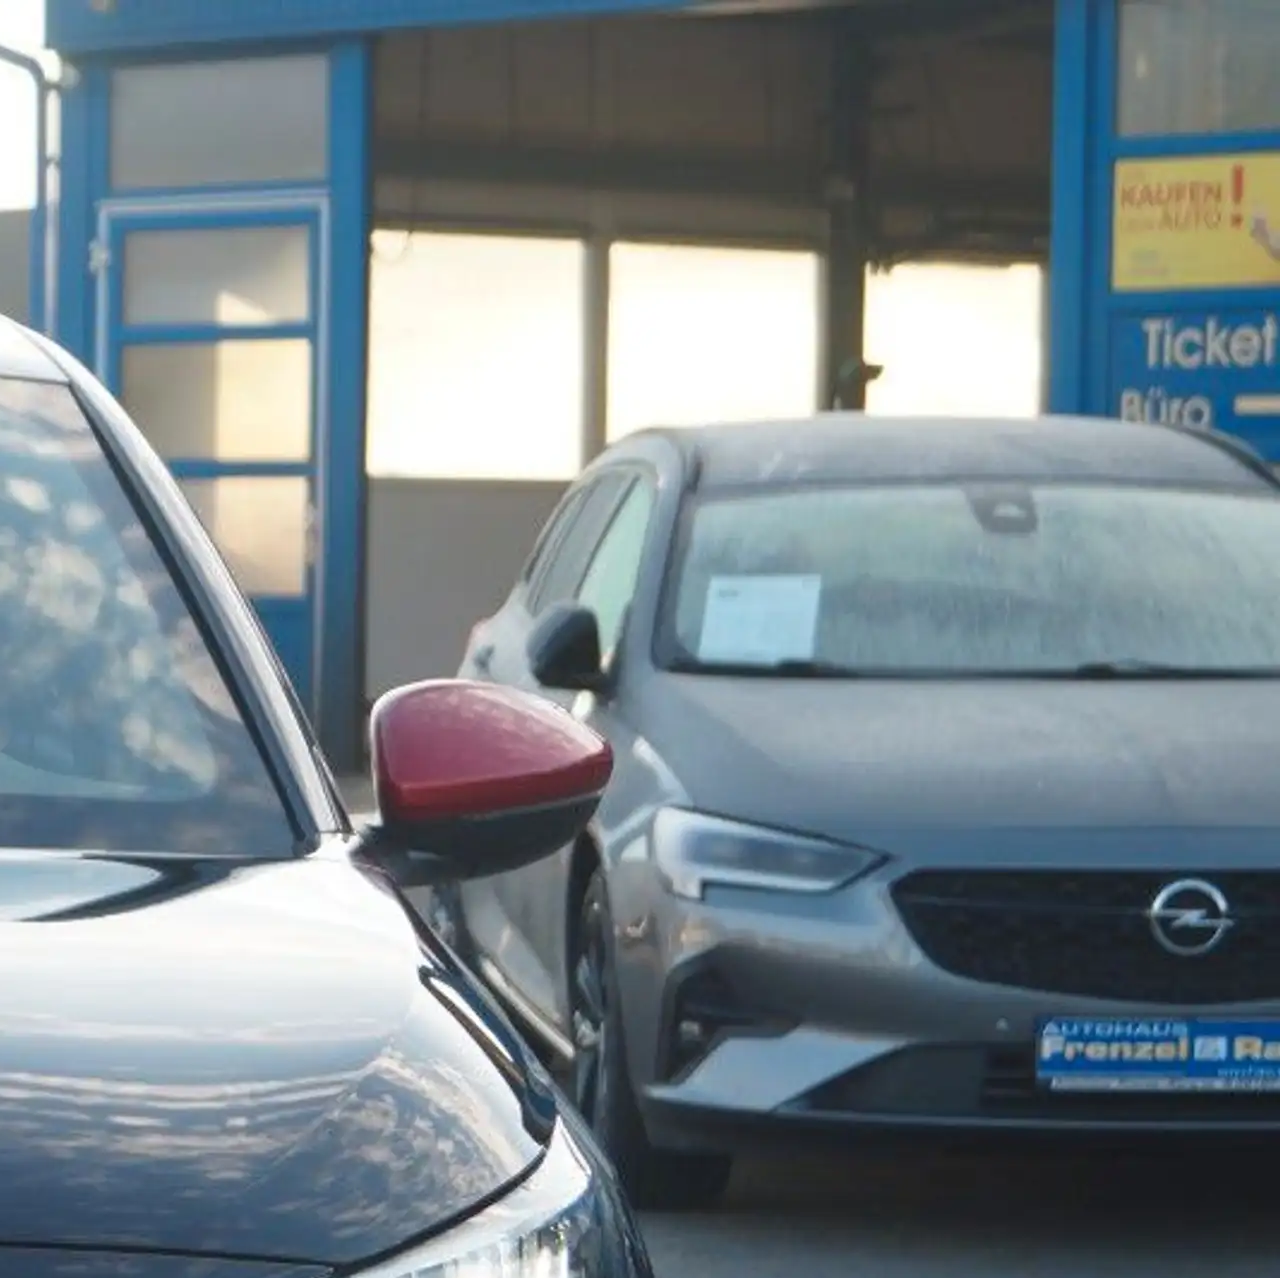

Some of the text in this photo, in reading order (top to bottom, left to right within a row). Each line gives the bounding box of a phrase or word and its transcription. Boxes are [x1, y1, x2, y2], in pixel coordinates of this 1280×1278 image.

[1142, 314, 1277, 369] Ticket
[1121, 386, 1211, 430] Büro
[1042, 1021, 1187, 1036] AUTOHAUS
[1042, 1036, 1188, 1061] Frenzel
